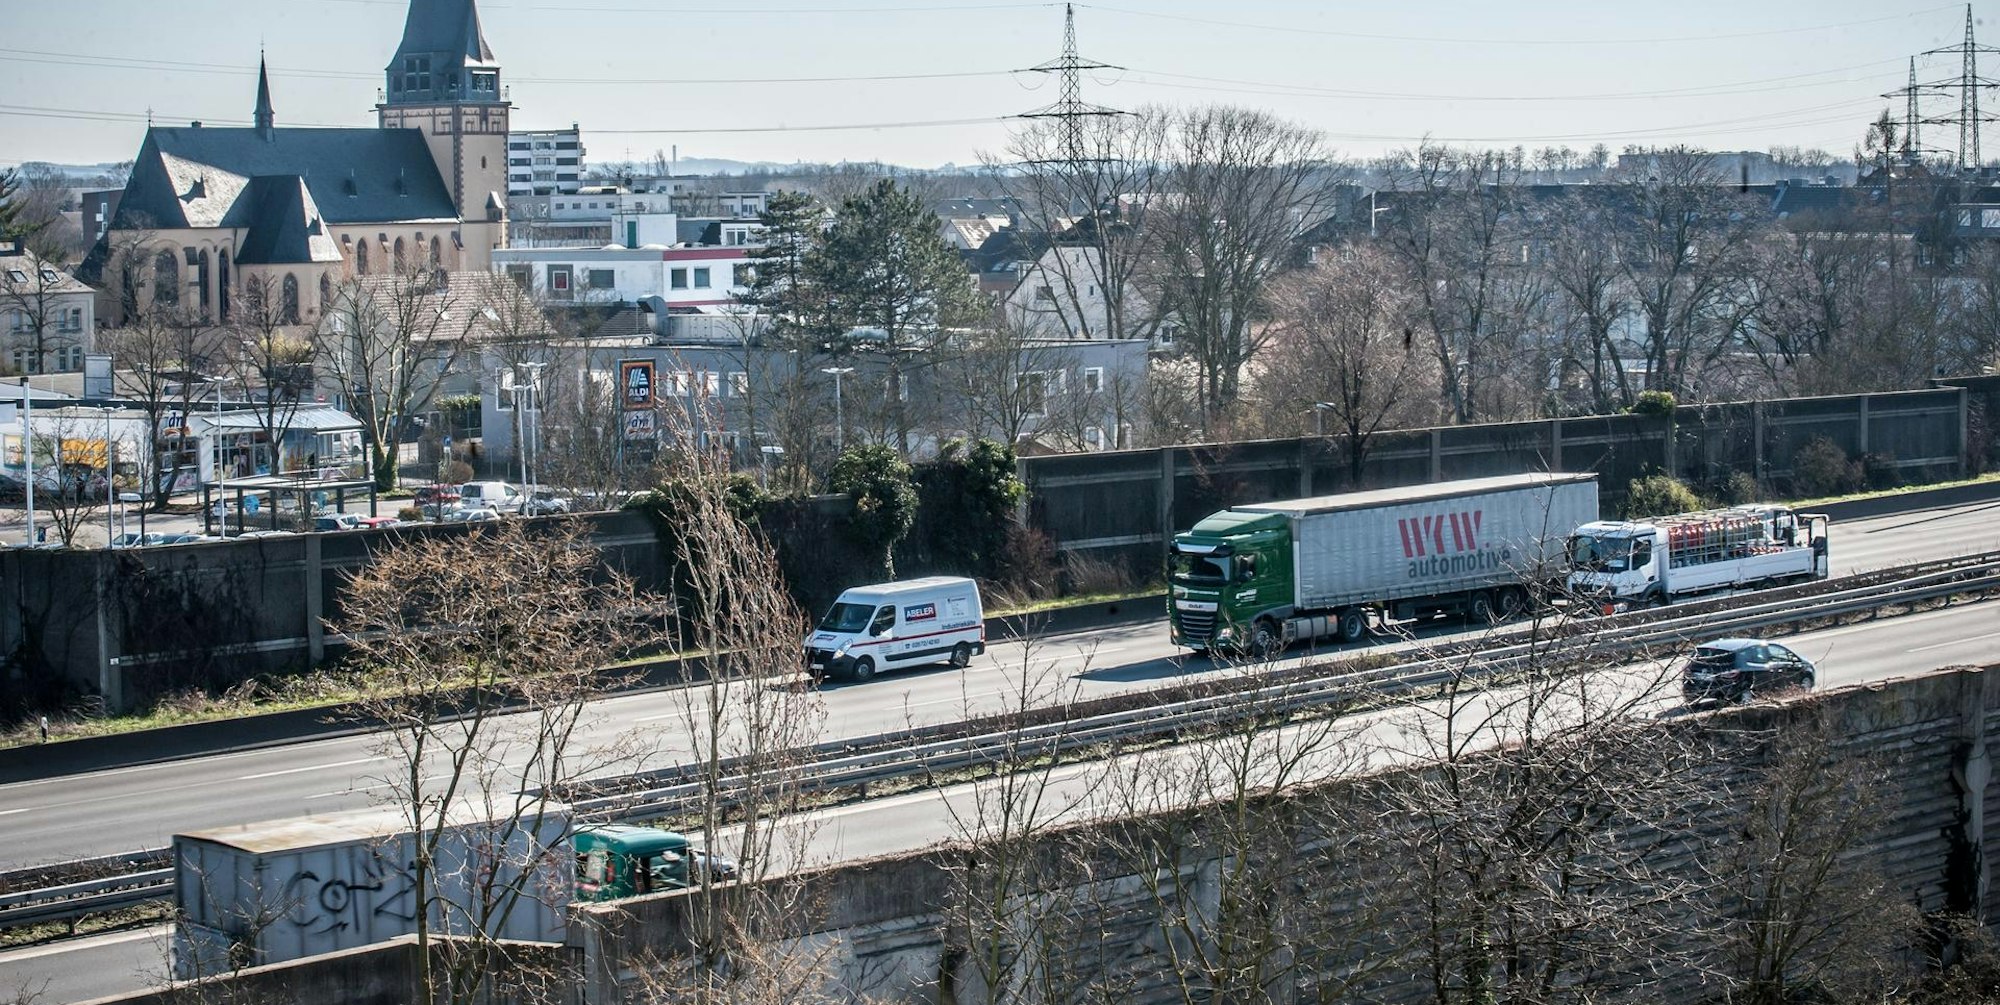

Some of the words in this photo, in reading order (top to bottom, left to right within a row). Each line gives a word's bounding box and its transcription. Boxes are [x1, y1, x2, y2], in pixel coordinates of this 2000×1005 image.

[629, 387, 649, 397] ALDI
[1398, 510, 1482, 558] WKW
[1408, 543, 1511, 578] automotive
[906, 606, 934, 618] ABELER
